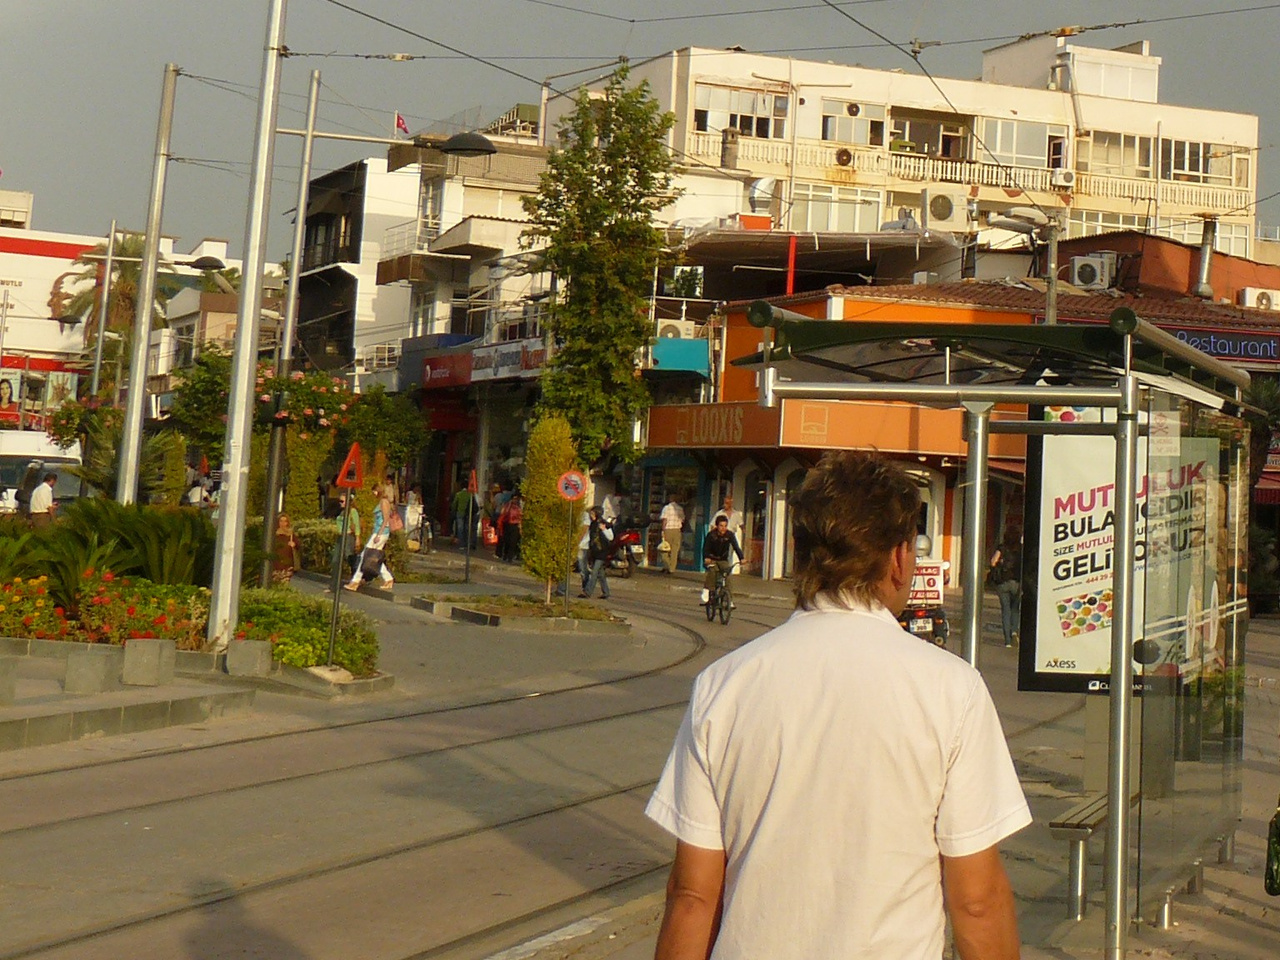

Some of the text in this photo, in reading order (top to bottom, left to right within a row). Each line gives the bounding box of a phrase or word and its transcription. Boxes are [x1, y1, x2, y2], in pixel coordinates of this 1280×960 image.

[1176, 330, 1278, 357] Restaurant
[691, 406, 744, 444] LOOXIS
[1085, 575, 1099, 584] 444
